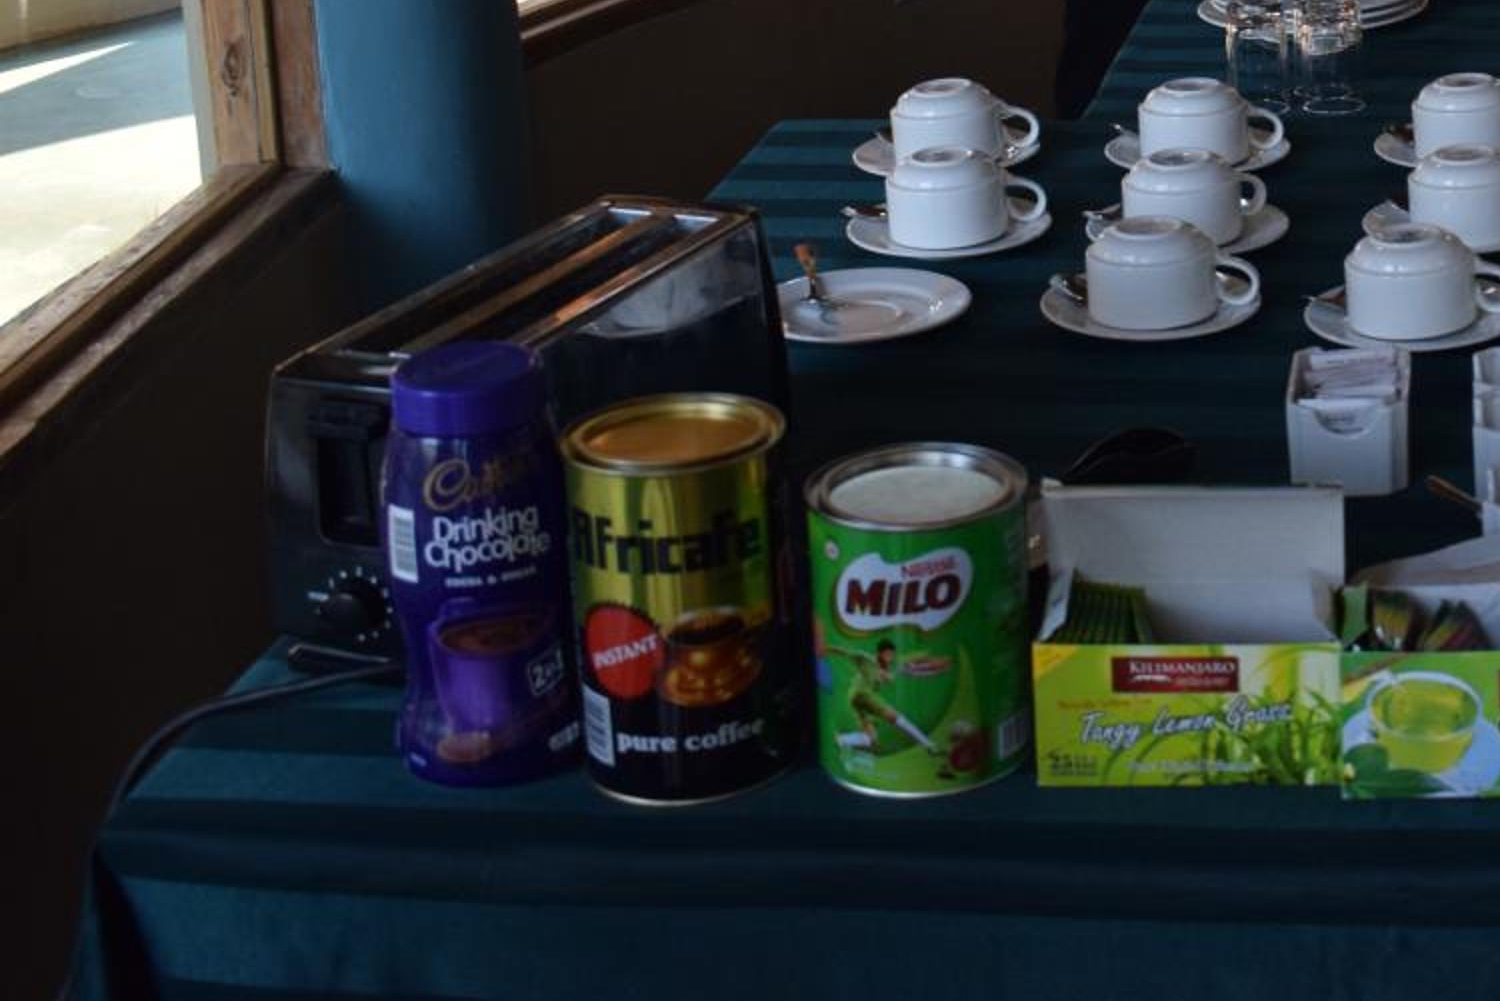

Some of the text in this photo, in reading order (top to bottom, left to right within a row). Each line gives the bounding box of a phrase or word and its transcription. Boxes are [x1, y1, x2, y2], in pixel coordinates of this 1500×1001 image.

[432, 505, 540, 544] Drinking
[423, 532, 552, 574] Chocolate
[845, 573, 961, 616] MILO
[592, 633, 657, 671] INSTANT
[616, 732, 678, 755] pure
